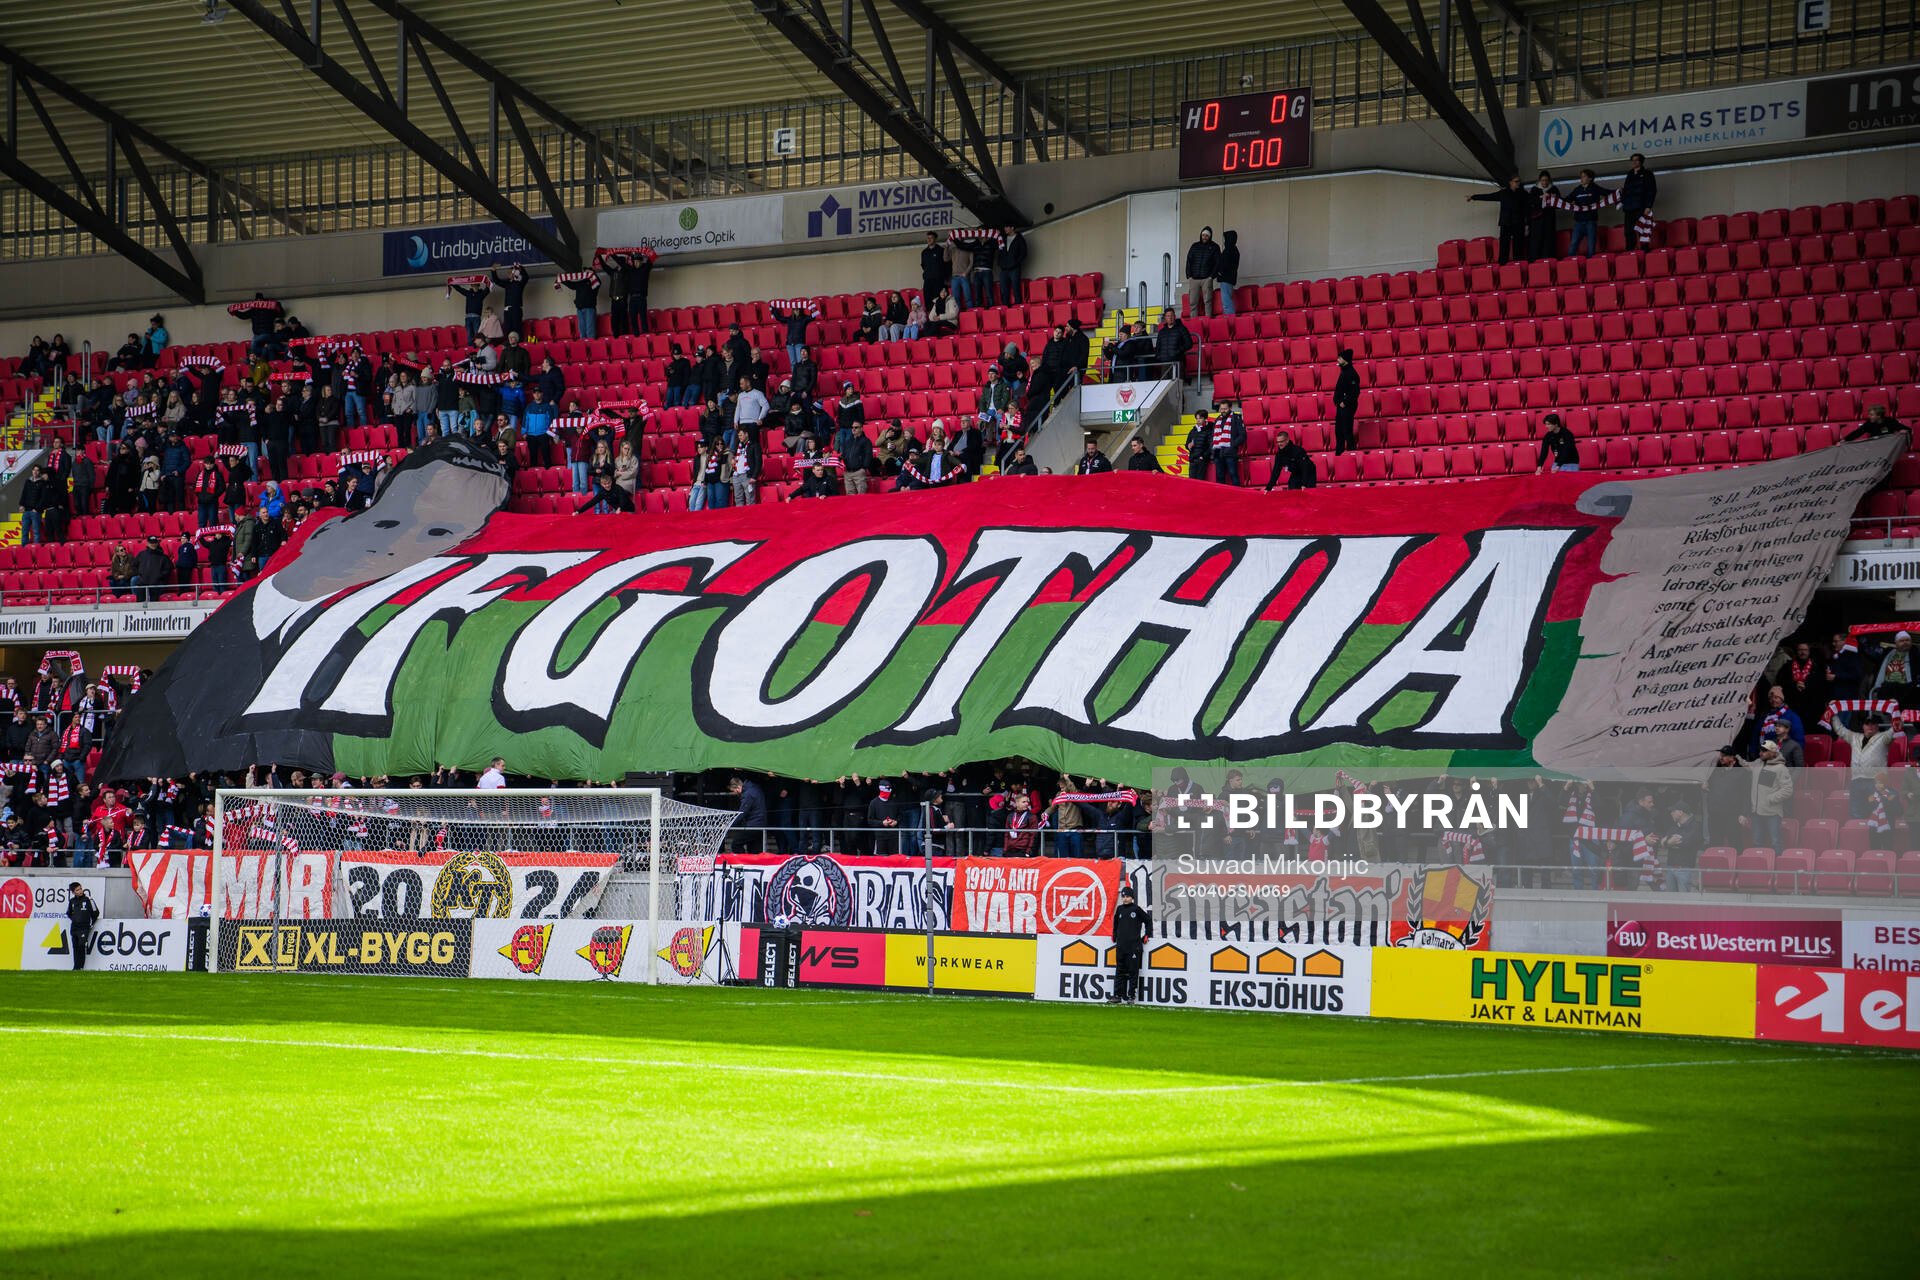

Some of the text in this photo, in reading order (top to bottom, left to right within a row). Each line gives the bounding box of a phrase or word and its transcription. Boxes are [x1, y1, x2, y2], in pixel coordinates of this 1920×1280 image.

[1804, 0, 1824, 29] E
[1186, 107, 1202, 129] H
[1203, 102, 1220, 131] 0
[1270, 94, 1287, 123] 0
[1290, 95, 1305, 118] G
[1581, 100, 1801, 142] HAMMARSTEDTS
[1848, 113, 1917, 130] QUALITY
[778, 130, 791, 153] E
[1612, 126, 1768, 153] KYL OCH INNEKLIMAT
[858, 183, 954, 209] MYSINGE
[858, 209, 953, 234] STENHUGGERI
[704, 230, 736, 246] Optik
[47, 616, 114, 636] Barometern
[122, 613, 192, 633] Barometern
[1702, 633, 1740, 650] hade
[1711, 652, 1734, 667] IF
[1711, 690, 1735, 705] till
[965, 866, 1040, 891] 1910% ANTI
[3, 894, 27, 914] NS
[964, 891, 1038, 934] VAR
[240, 930, 294, 965] XL
[303, 931, 456, 965] XL-BYGG
[1619, 930, 1647, 947] BW
[1656, 931, 1832, 955] Best Western PLUS
[109, 963, 168, 972] SAINT-GOBAIN
[764, 942, 777, 987] SELECT
[787, 943, 798, 988] SELECT
[916, 956, 1004, 970] WORKWEAR
[1210, 977, 1344, 1012] EKSJÖHUS
[1471, 957, 1642, 1008] HYLTE
[1471, 1003, 1641, 1028] JAKT & LANTMAN
